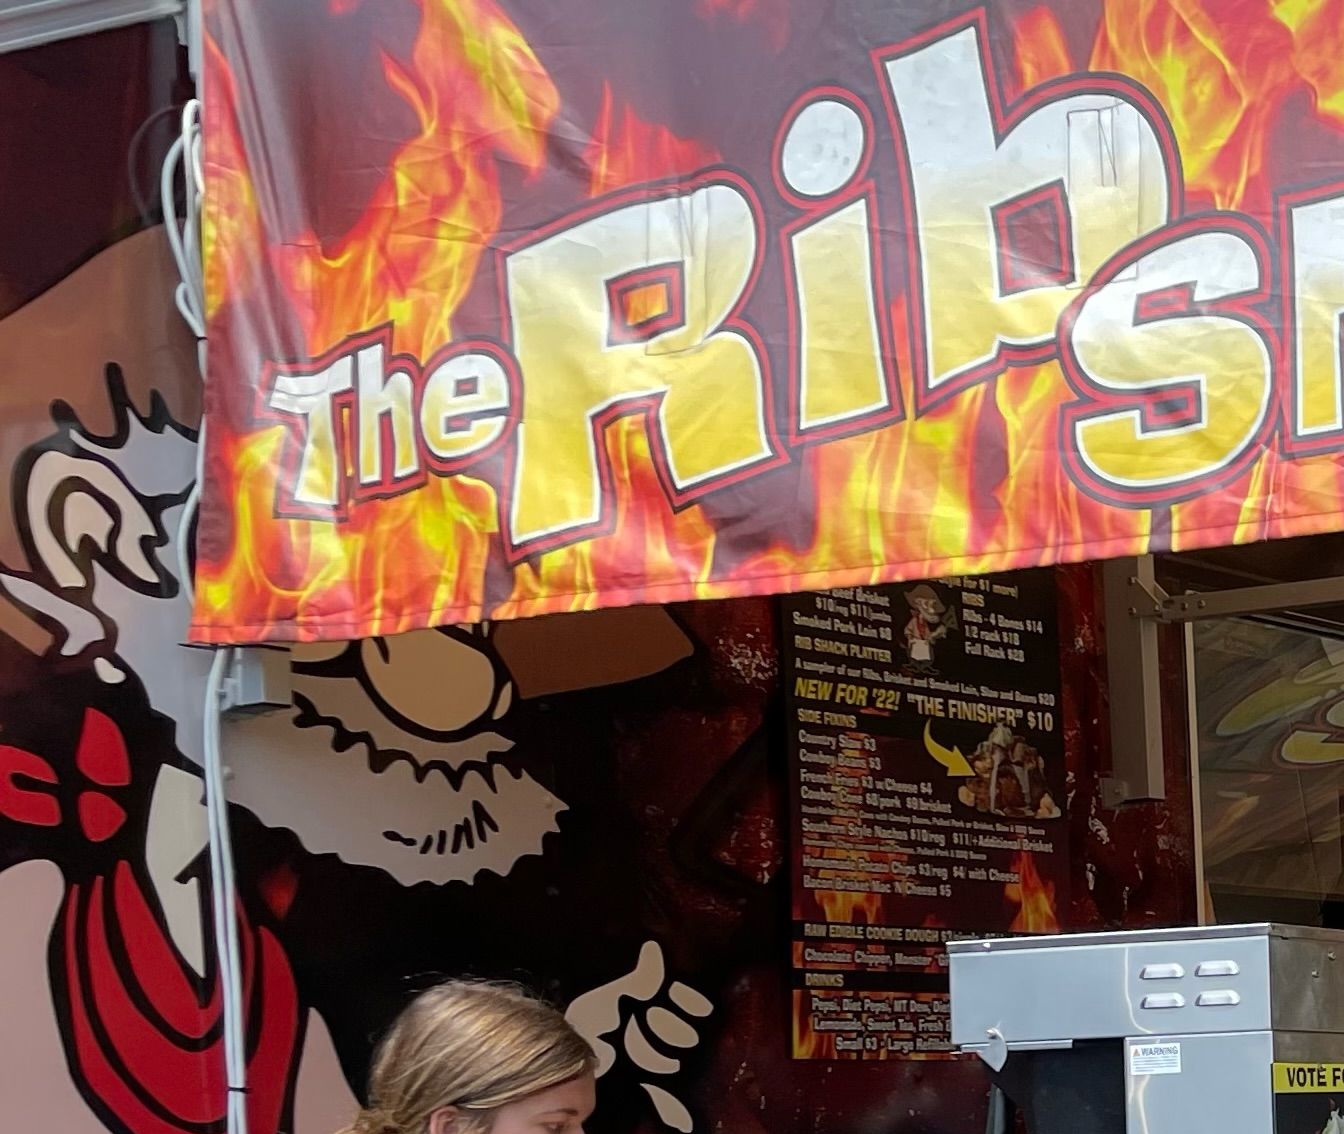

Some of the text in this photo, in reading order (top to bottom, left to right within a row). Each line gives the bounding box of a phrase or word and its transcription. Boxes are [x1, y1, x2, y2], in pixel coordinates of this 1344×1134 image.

[271, 26, 1168, 546] The Rib
[813, 637, 850, 657] SHACK
[849, 643, 893, 664] PLATTER
[794, 676, 834, 702] NEW
[834, 682, 870, 707] FOR
[871, 686, 902, 712] '22!
[1026, 710, 1055, 733] $10
[804, 972, 846, 988] DRINKS
[1286, 1066, 1327, 1088] VOTE
